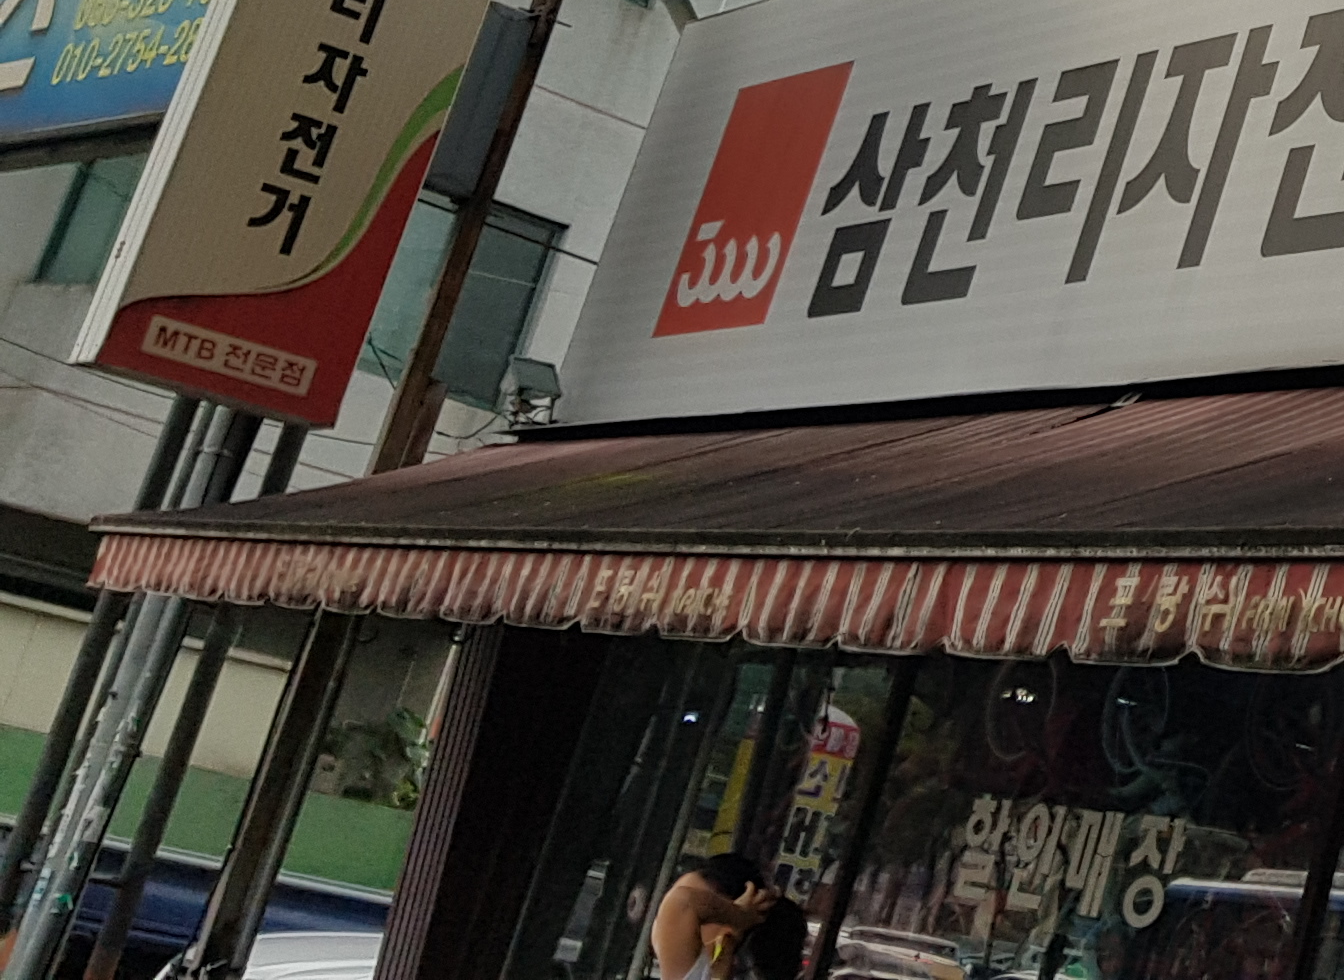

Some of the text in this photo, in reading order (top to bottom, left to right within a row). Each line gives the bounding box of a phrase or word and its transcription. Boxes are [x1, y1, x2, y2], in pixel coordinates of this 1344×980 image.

[153, 325, 306, 388] MTB 전문점
[953, 793, 1188, 930] 할인매장
